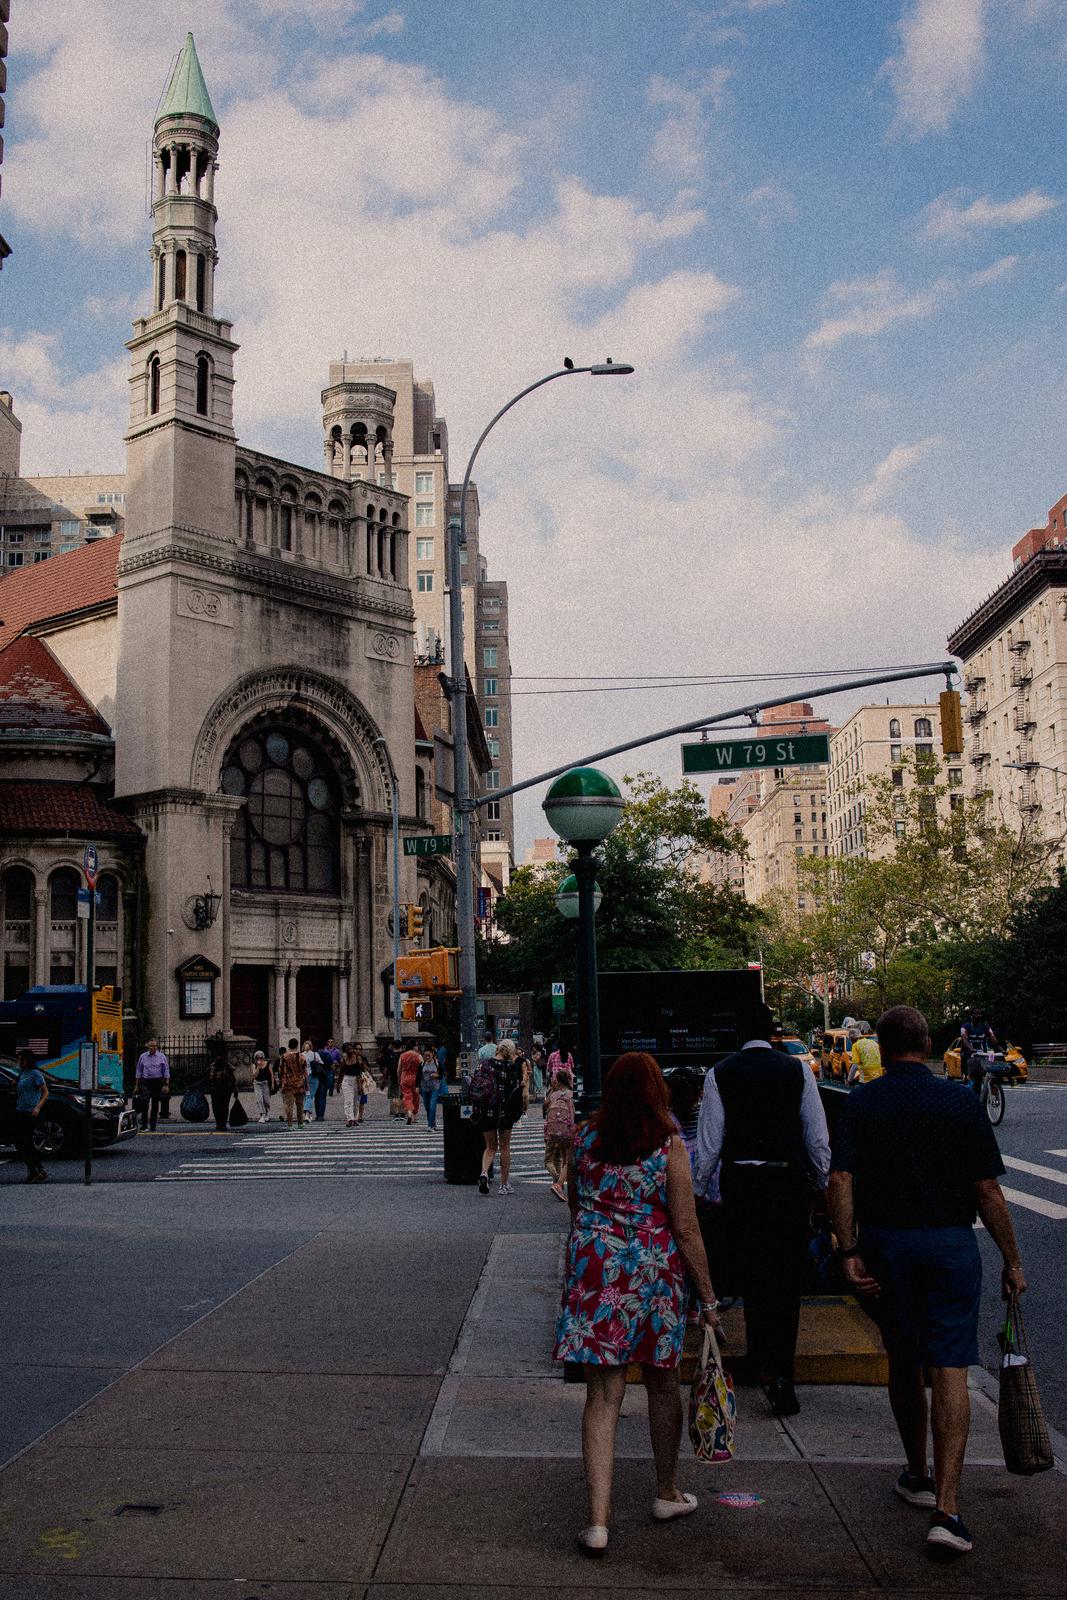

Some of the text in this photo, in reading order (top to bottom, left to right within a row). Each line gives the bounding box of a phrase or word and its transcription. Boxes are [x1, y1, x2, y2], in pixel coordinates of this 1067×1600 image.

[716, 741, 796, 766] W 79 St
[406, 838, 450, 853] W 79 St
